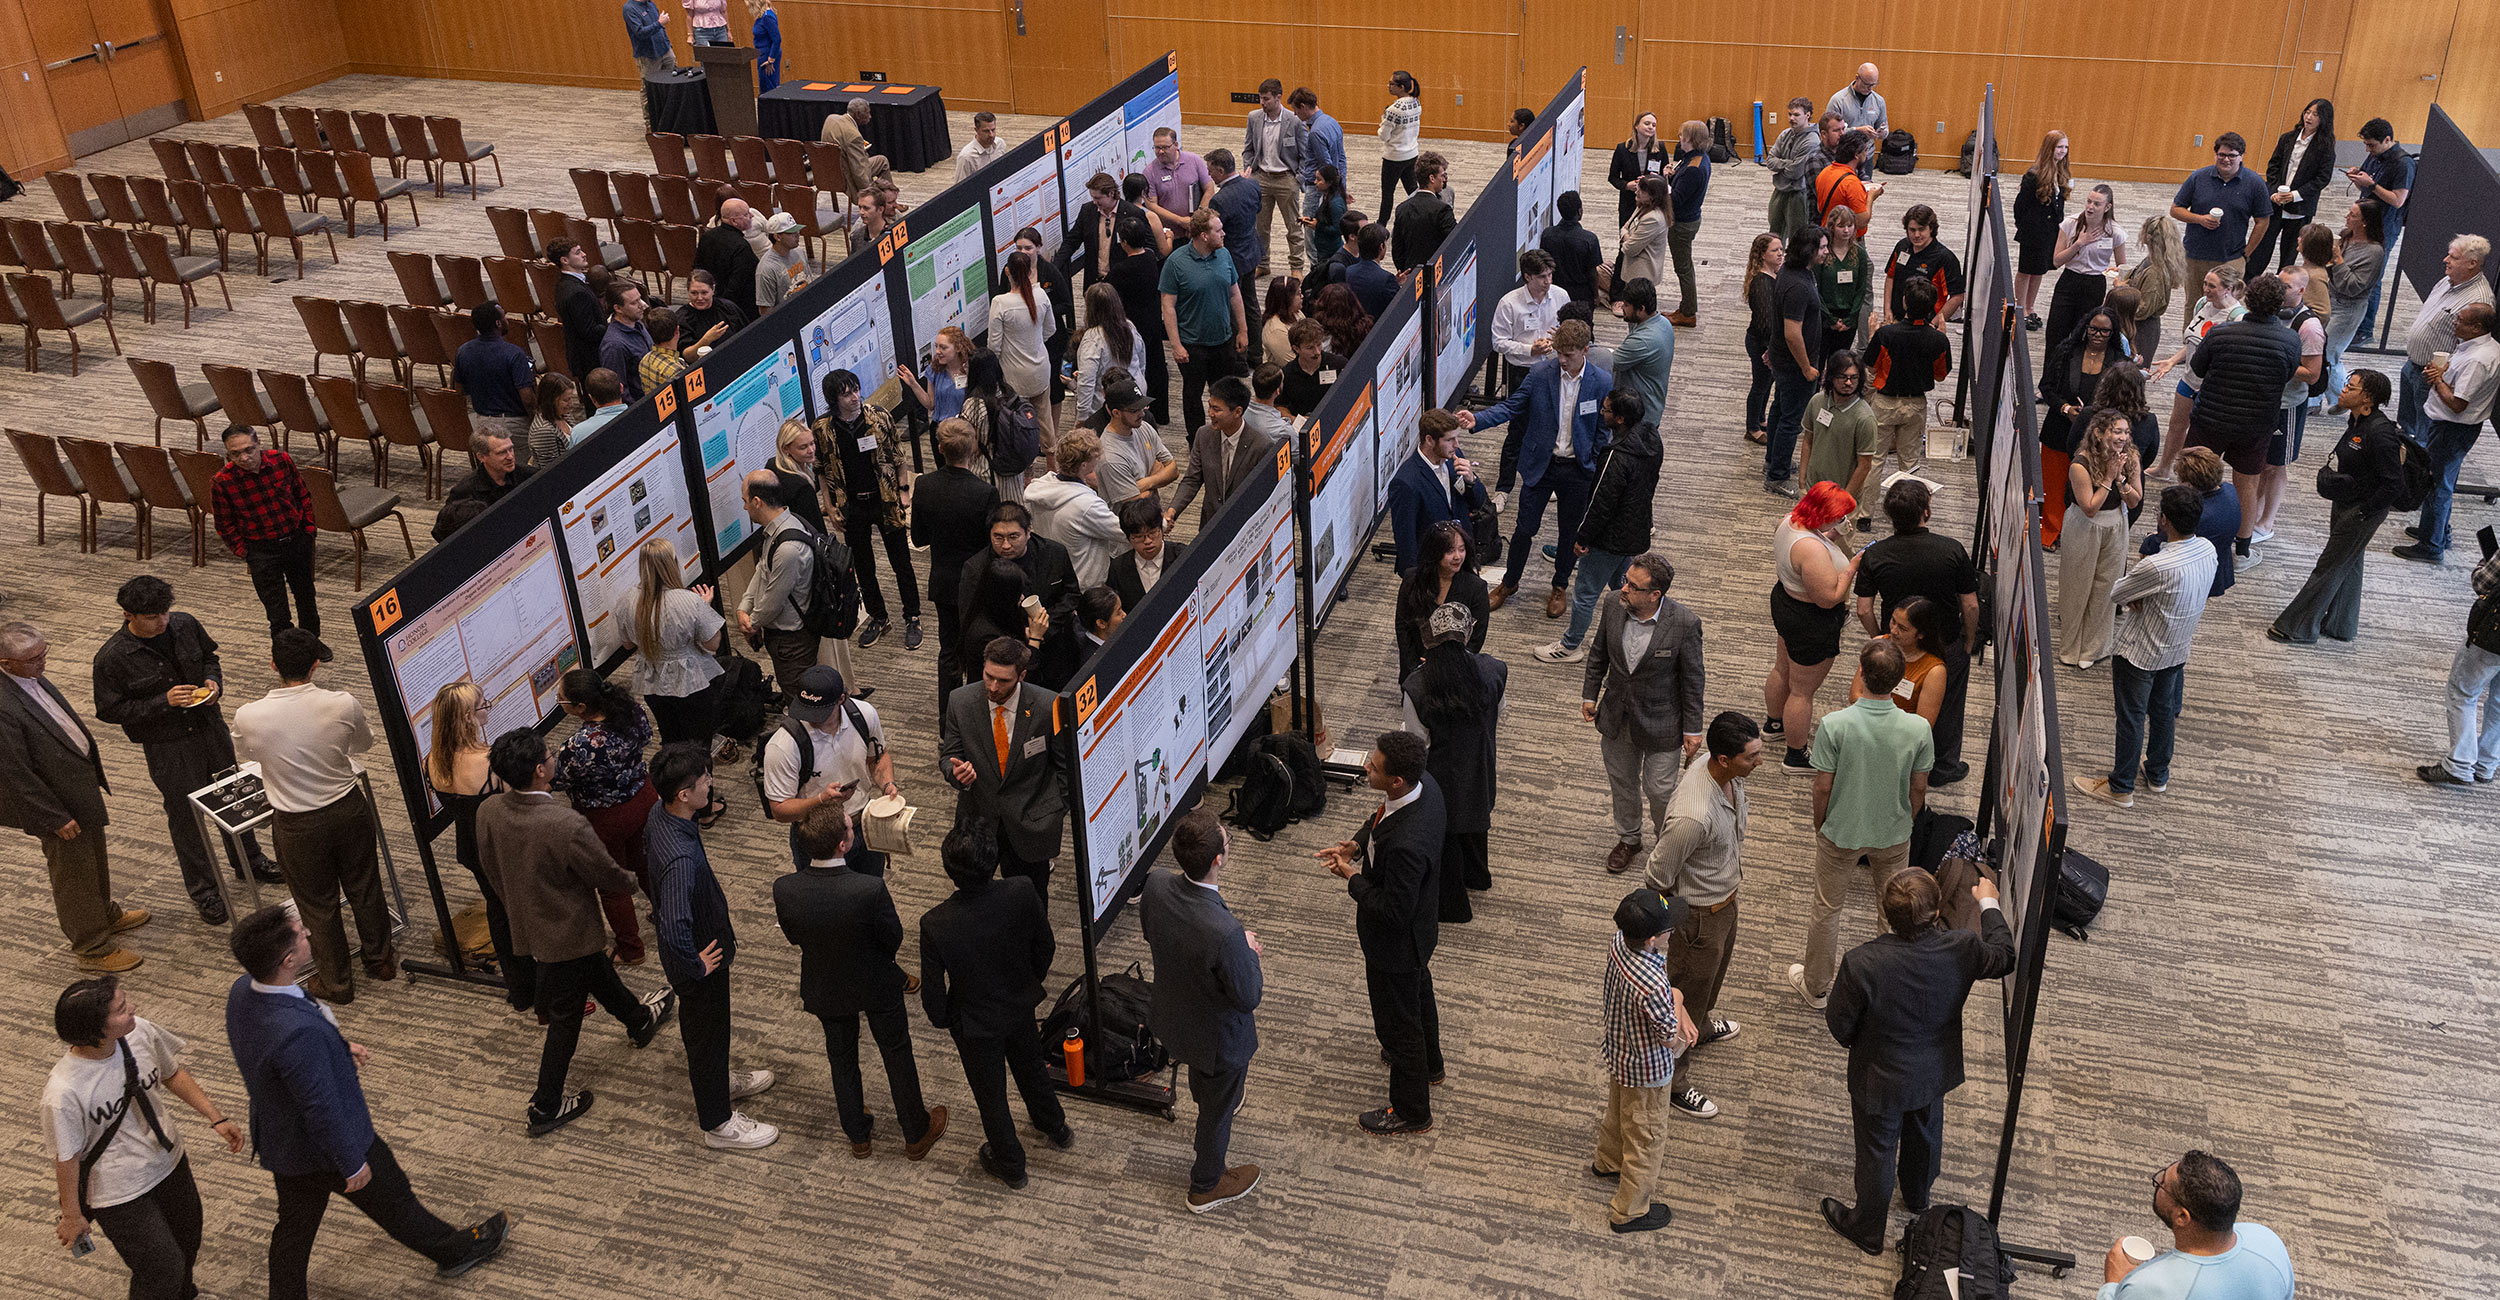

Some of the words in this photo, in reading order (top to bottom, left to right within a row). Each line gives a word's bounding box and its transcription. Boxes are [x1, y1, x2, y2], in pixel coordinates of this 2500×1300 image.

[1046, 134, 1054, 146] 11
[1061, 124, 1070, 138] 10
[895, 226, 906, 242] 12
[881, 242, 891, 258] 13
[688, 374, 702, 392] 14
[659, 392, 676, 413] 15
[1310, 427, 1319, 448] 30
[1280, 449, 1289, 470] 31
[376, 597, 397, 622] 16
[406, 620, 428, 642] HONORS
[406, 628, 430, 648] COLLEGE
[1078, 685, 1095, 713] 32
